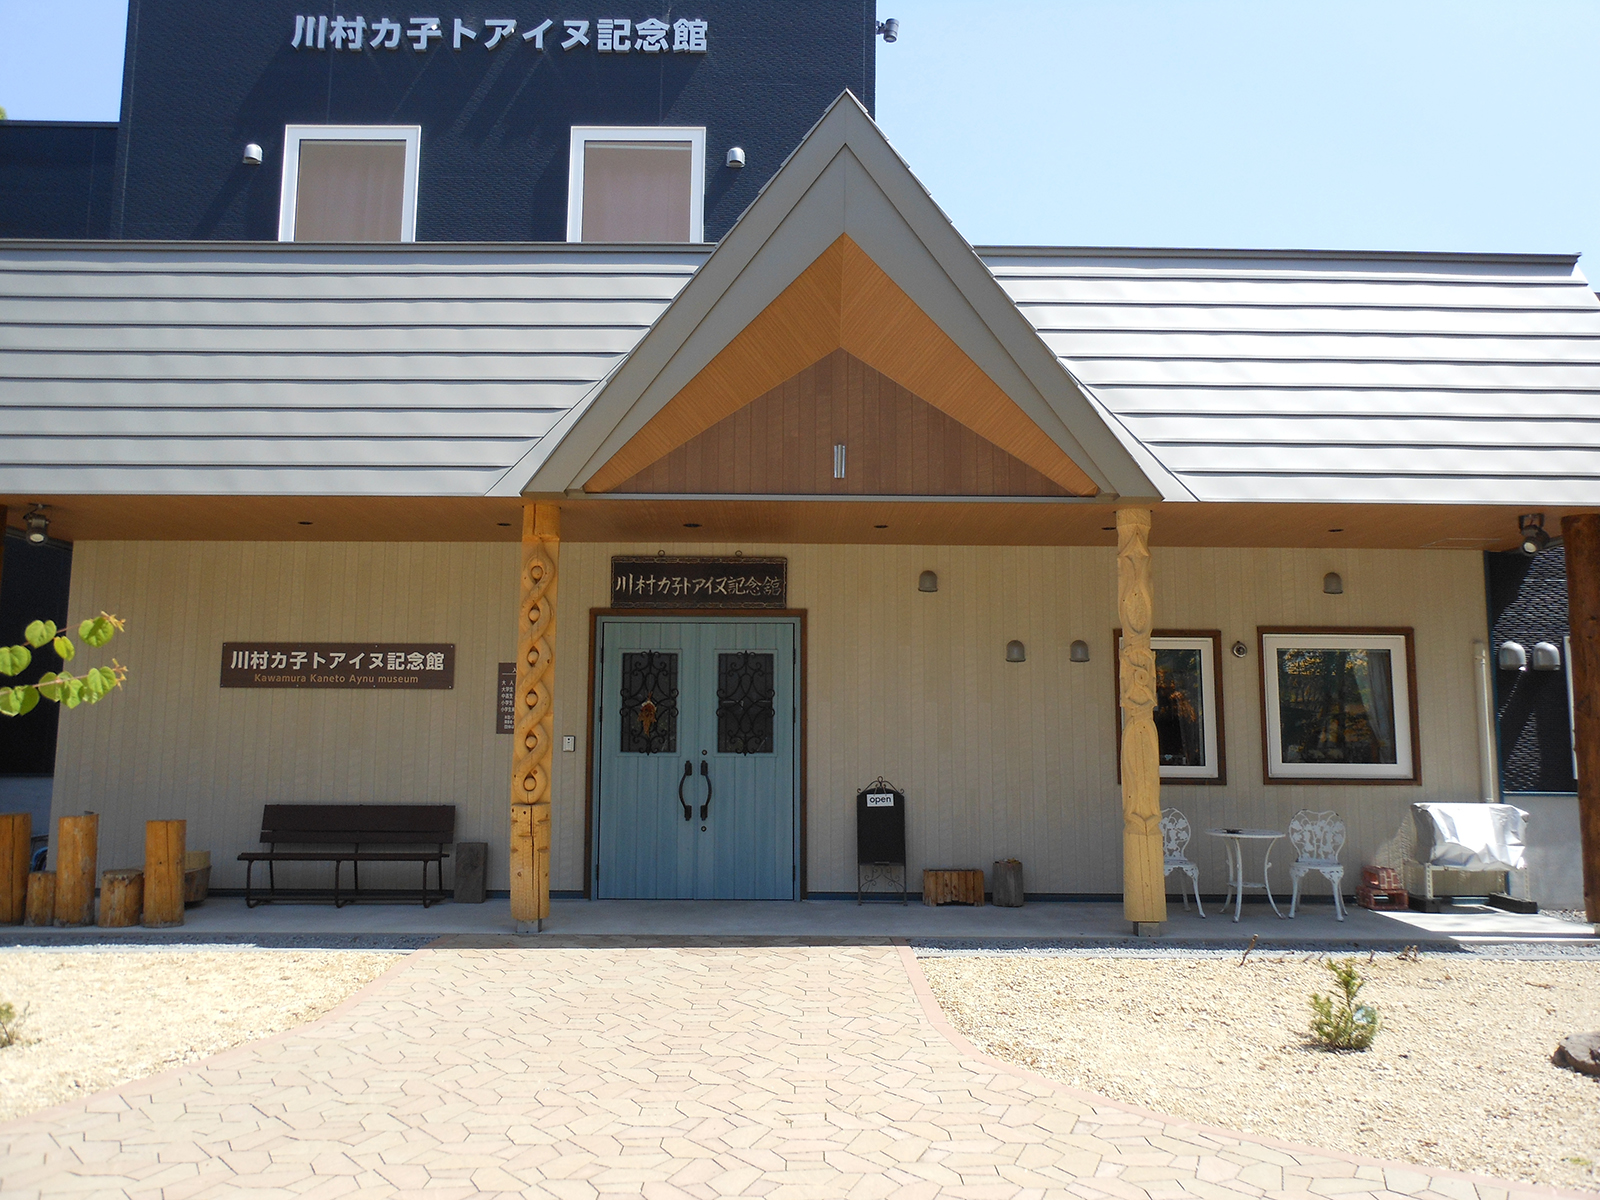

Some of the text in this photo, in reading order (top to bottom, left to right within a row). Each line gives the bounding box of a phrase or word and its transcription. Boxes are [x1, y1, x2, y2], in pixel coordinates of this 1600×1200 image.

[291, 15, 709, 53] 川村カ子トアイヌ記念館
[230, 650, 445, 671] 川村カ子トアイヌ記念館
[254, 673, 419, 686] Kawamura Kaneto Aynu museum
[869, 797, 892, 805] open
